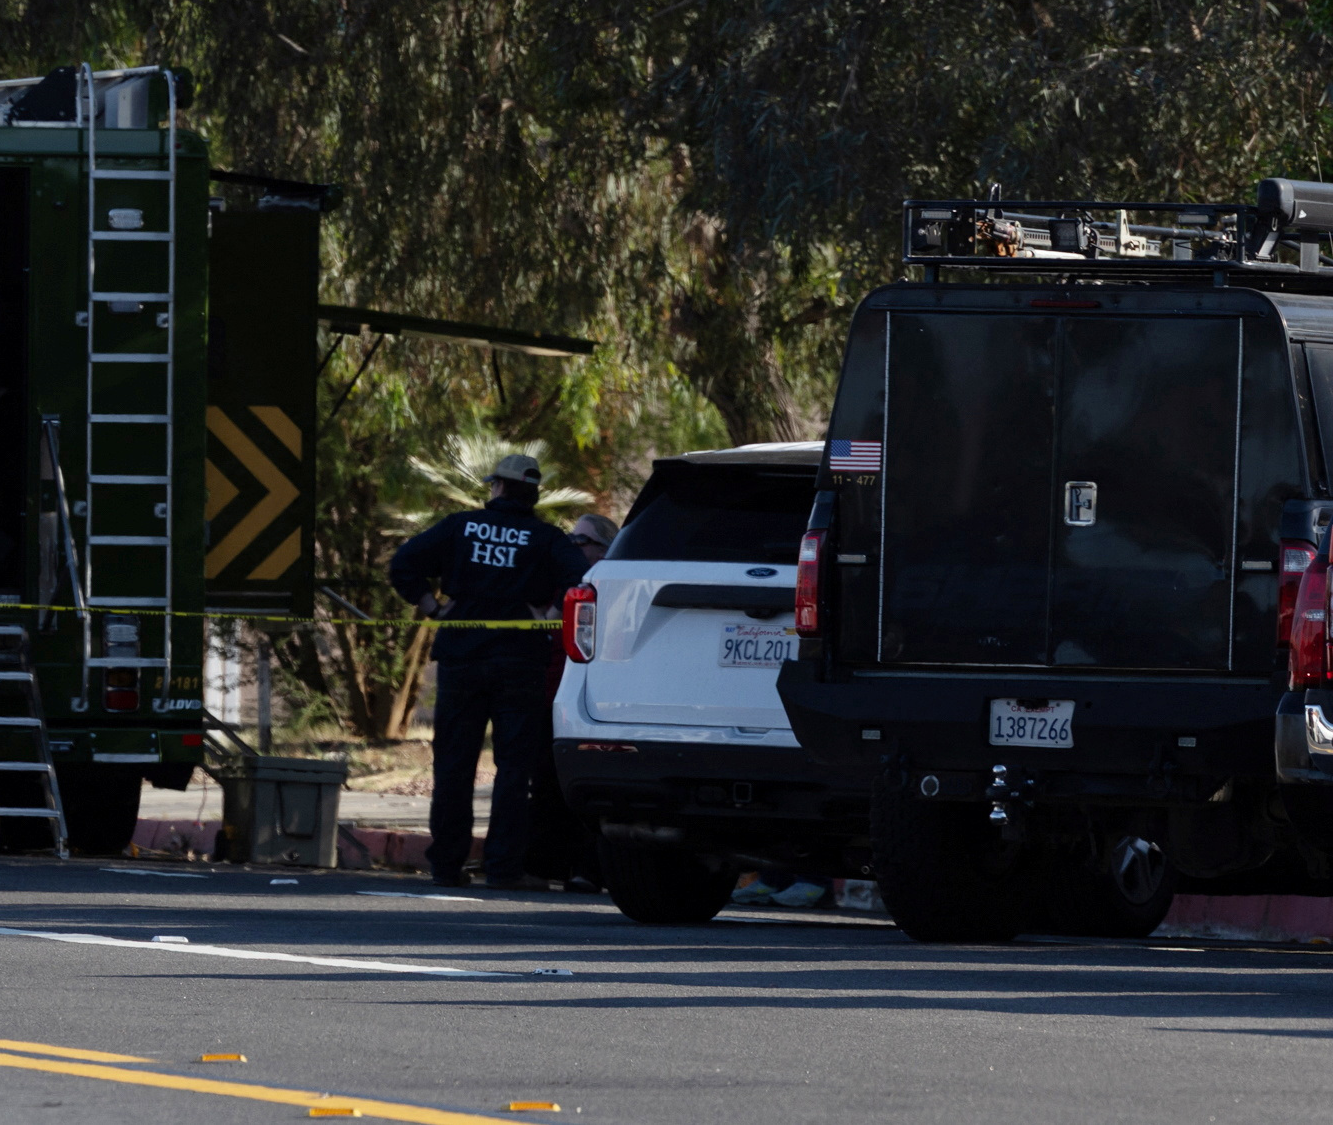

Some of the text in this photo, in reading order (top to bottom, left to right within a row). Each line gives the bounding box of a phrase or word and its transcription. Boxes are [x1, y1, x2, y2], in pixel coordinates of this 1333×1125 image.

[464, 521, 531, 545] POLICE
[470, 541, 518, 567] HSI
[736, 626, 786, 639] California
[723, 638, 792, 661] 9KCL201
[154, 676, 199, 690] 2-181
[994, 716, 1070, 741] 1387266
